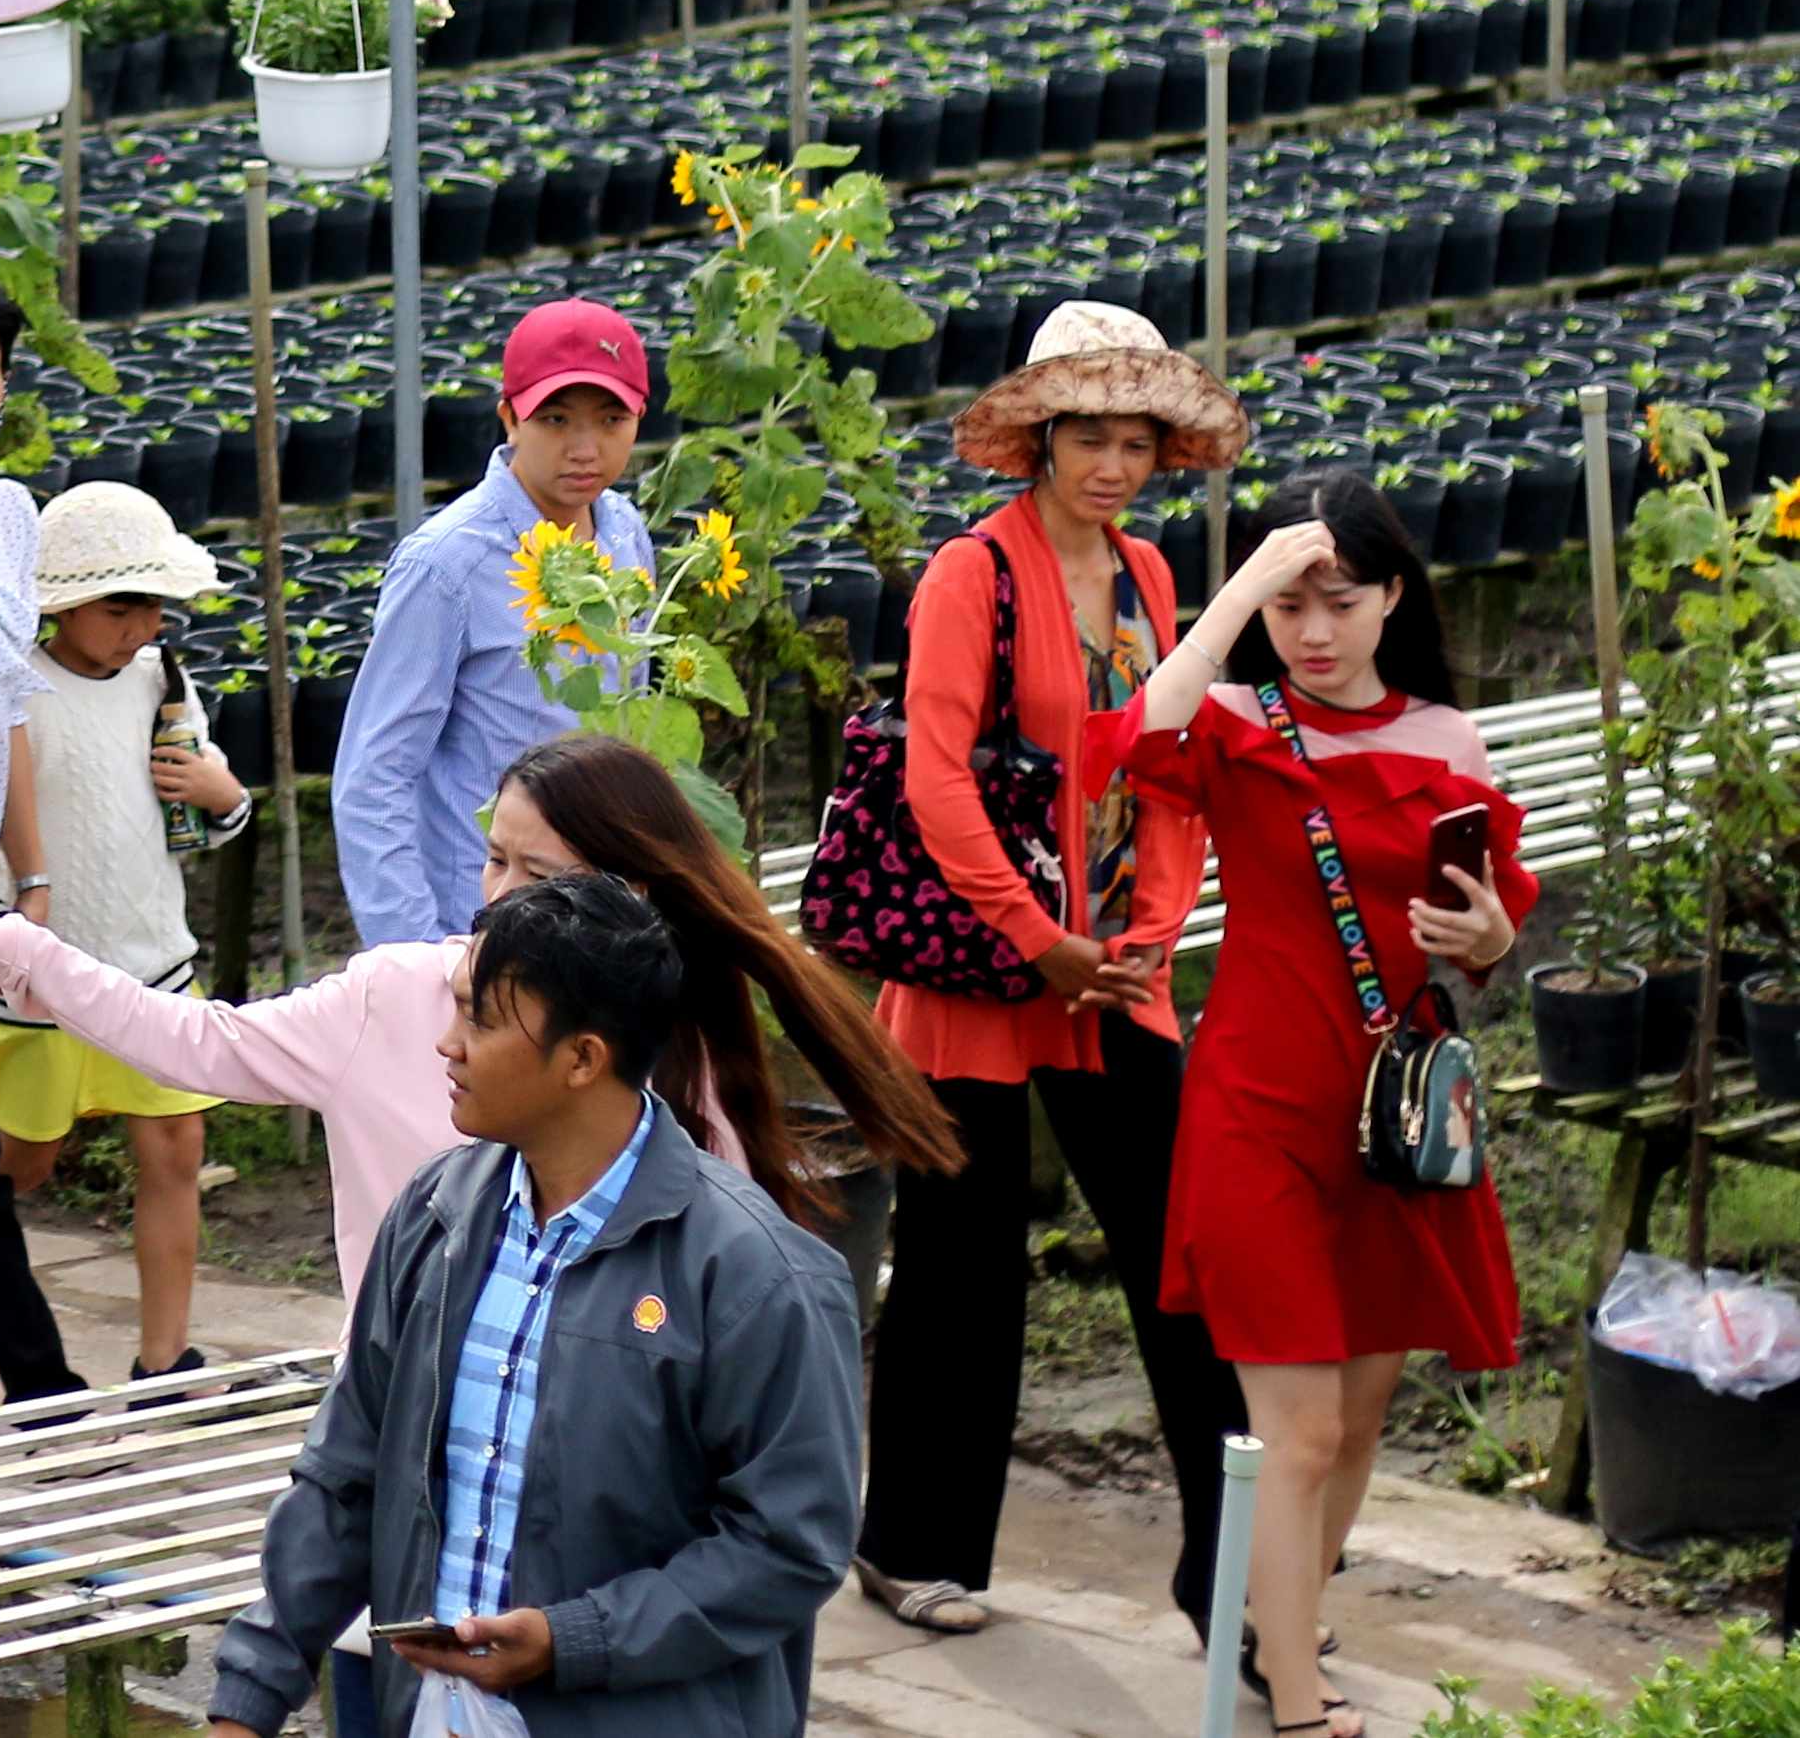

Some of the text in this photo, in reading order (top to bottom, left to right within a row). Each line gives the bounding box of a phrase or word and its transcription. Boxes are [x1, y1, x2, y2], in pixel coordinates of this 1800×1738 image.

[1257, 681, 1292, 728] LOVE
[1316, 847, 1354, 911] LOVE
[1336, 912, 1374, 976] LOVE
[1357, 978, 1387, 1022] LOV
